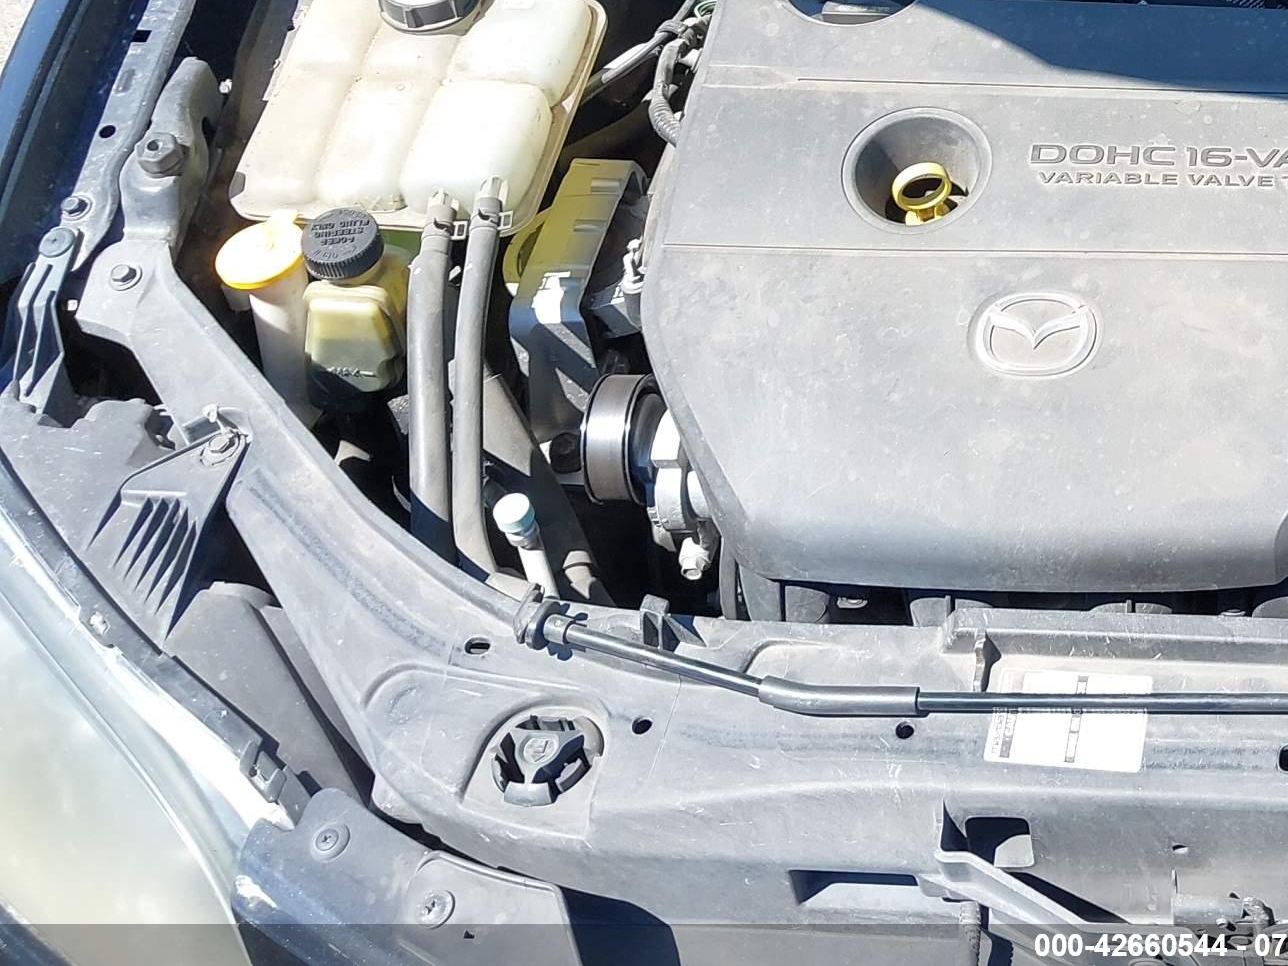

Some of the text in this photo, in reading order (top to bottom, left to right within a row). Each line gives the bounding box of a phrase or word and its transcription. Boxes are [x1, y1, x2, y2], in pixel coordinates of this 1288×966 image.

[1030, 144, 1176, 166] DOHC
[1038, 171, 1179, 186] VARIABLE
[1187, 173, 1275, 187] VALVE
